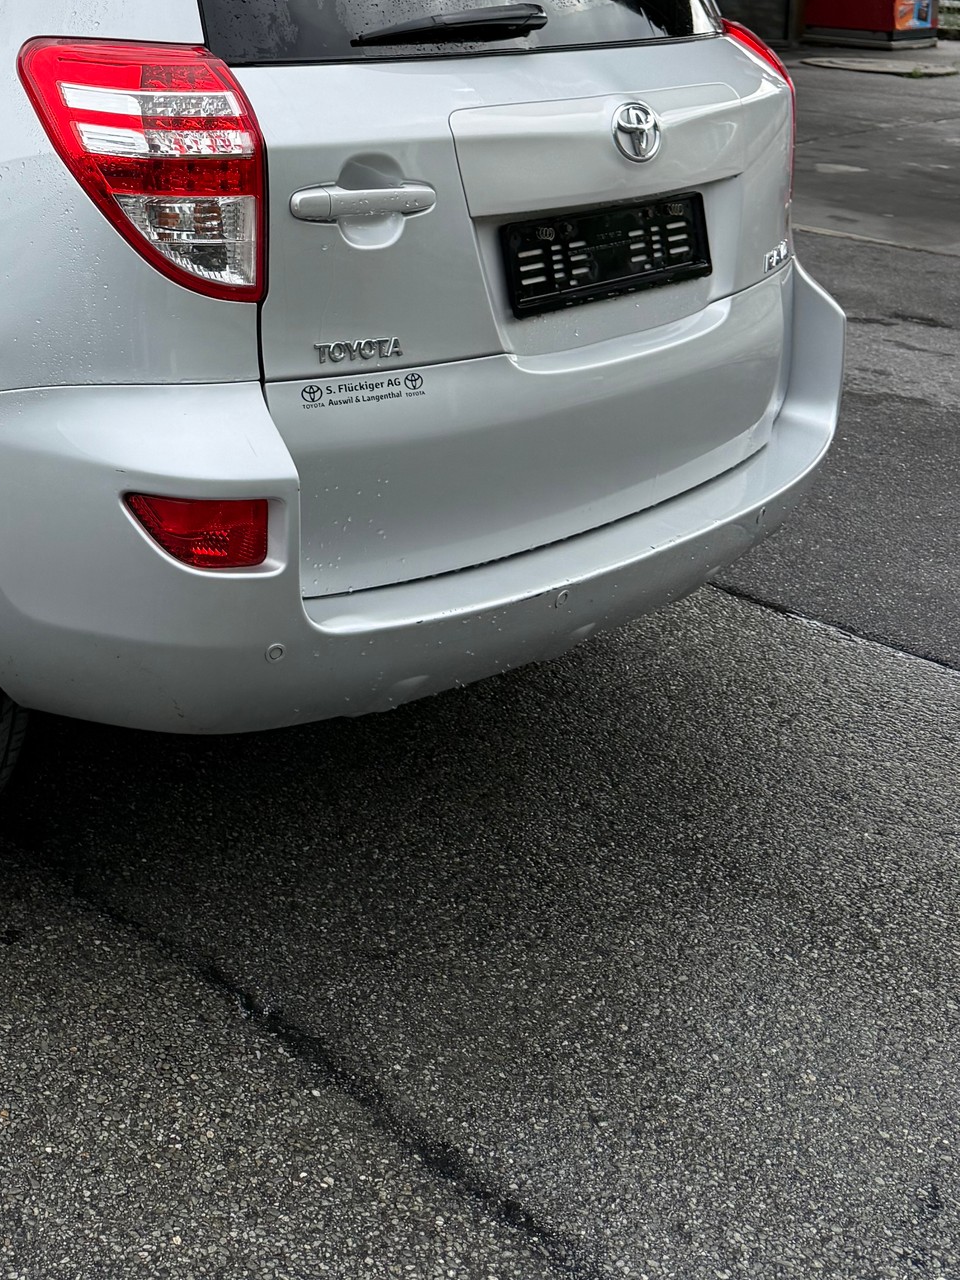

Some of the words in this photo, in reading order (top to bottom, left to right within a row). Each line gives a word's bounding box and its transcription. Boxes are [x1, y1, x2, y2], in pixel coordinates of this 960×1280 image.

[313, 336, 404, 365] TOYOTA
[325, 386, 337, 396] S.
[337, 379, 385, 394] Flückiger
[386, 377, 402, 388] AG
[302, 402, 326, 410] TOYOTA
[328, 396, 354, 407] Auswil
[354, 395, 361, 404] &
[361, 391, 403, 403] Langenthal
